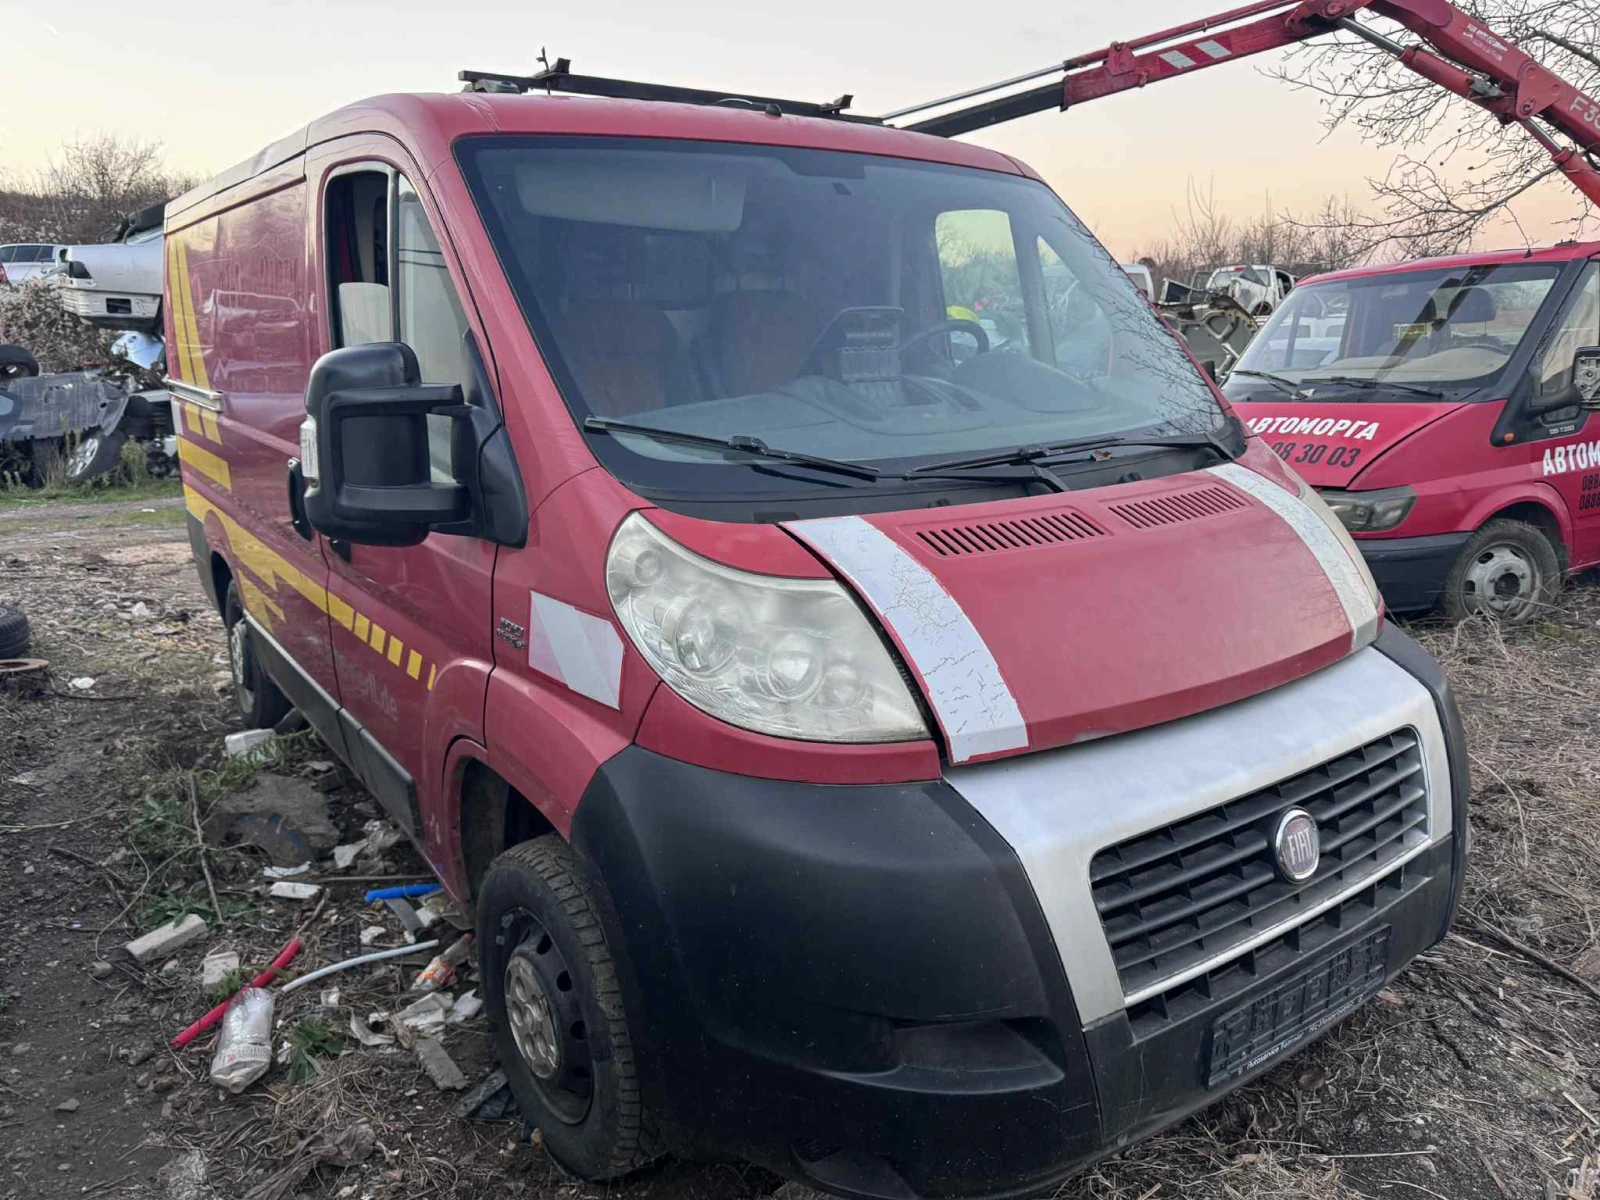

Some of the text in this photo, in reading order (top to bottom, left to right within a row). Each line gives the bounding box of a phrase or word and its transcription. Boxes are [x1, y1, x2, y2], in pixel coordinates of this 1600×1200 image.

[1296, 443, 1327, 464] 30
[1326, 446, 1361, 468] 03
[1287, 828, 1313, 865] FIAT
